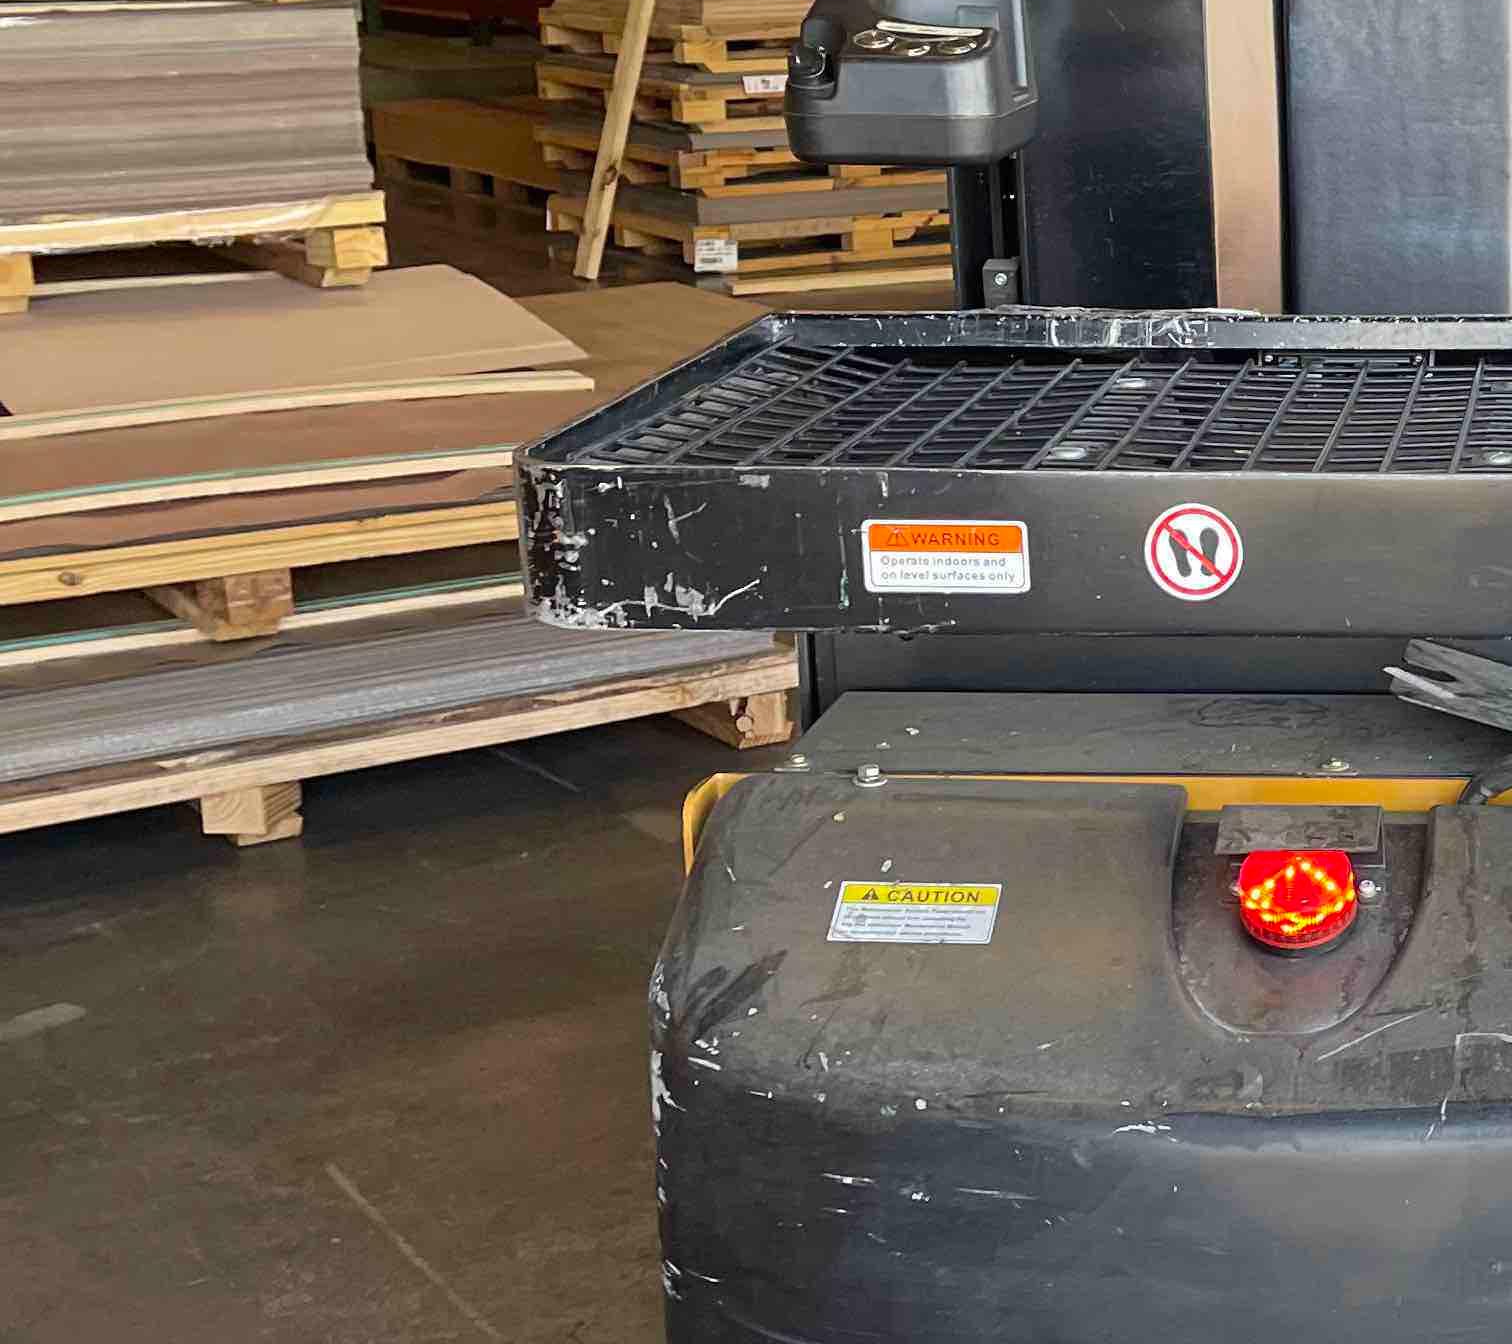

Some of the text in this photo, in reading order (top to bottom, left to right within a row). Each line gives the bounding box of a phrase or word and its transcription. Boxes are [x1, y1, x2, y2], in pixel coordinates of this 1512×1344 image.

[911, 532, 1000, 546] WARNING
[880, 555, 1006, 567] Operate indoors and
[881, 570, 1015, 583] on level surfaces only
[887, 889, 981, 903] CAUTION
